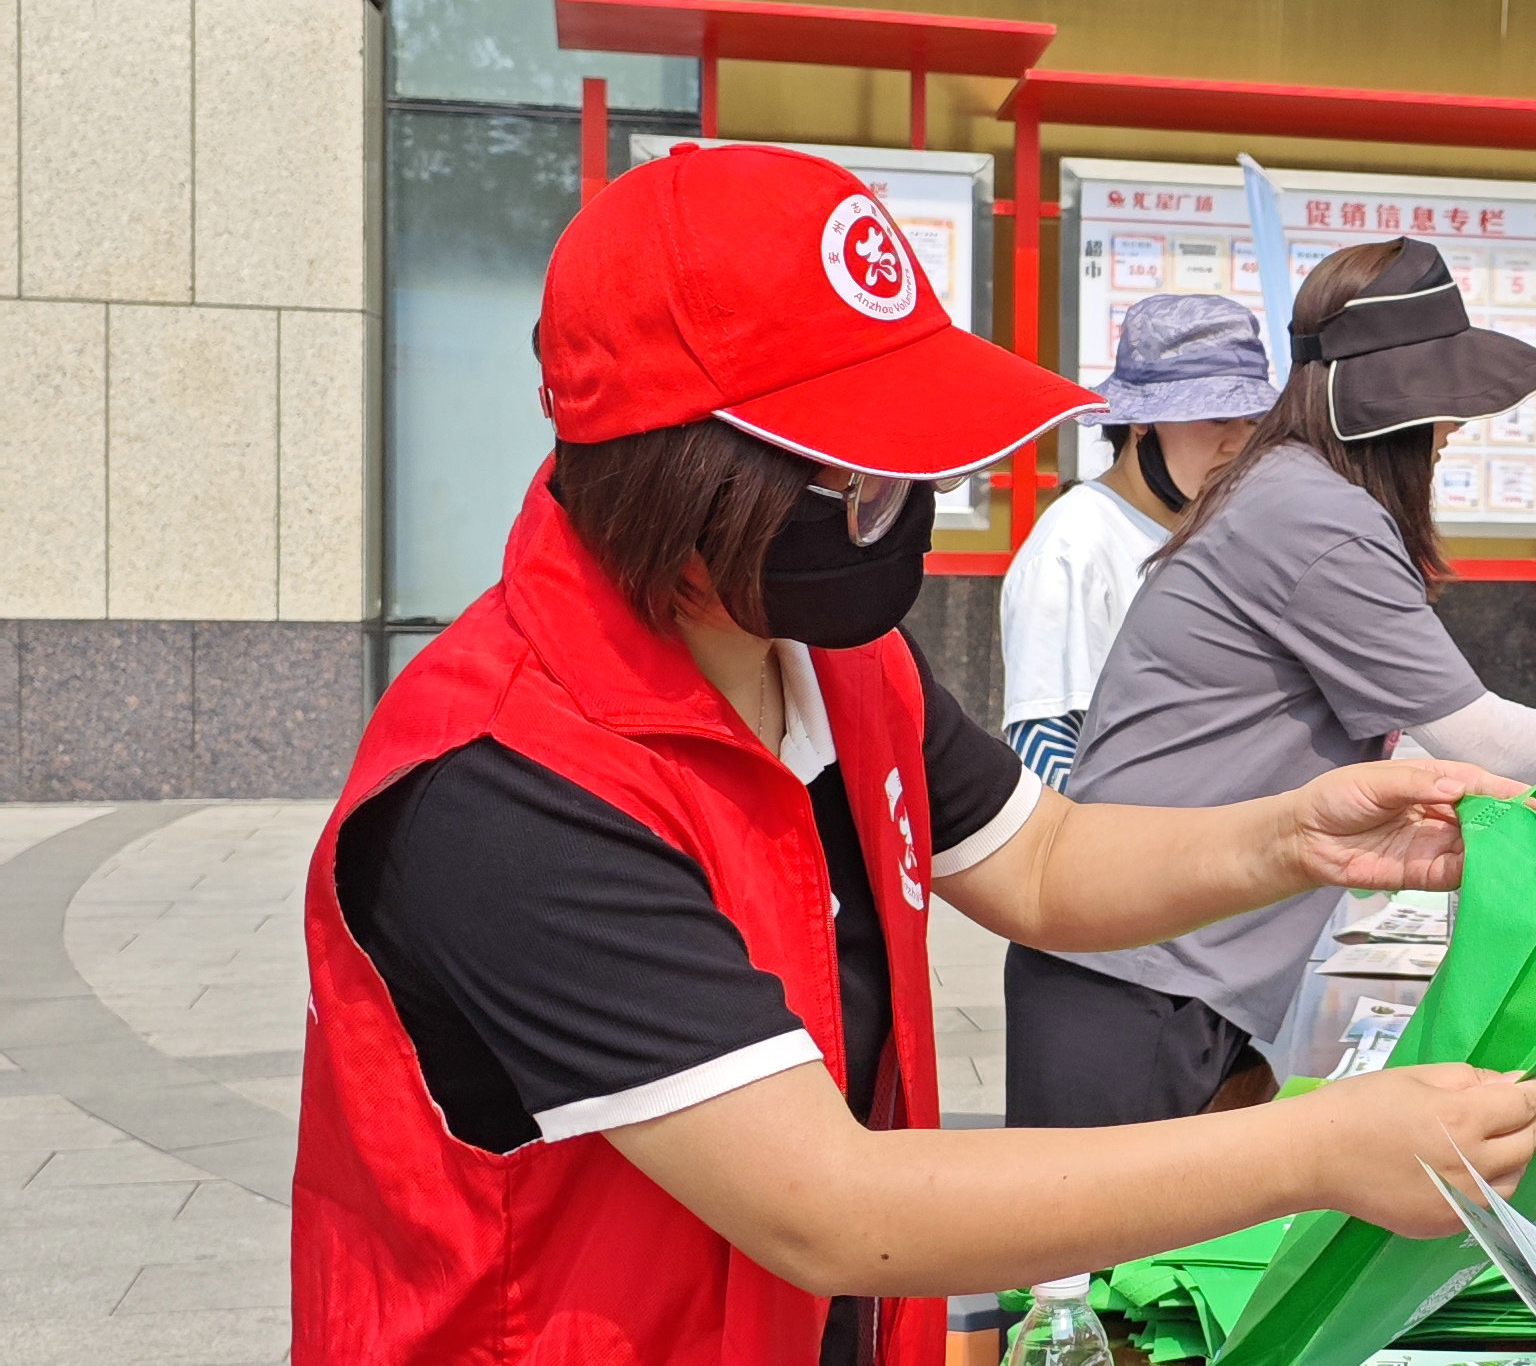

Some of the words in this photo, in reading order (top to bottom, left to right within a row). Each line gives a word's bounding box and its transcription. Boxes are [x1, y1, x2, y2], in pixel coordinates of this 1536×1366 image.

[1305, 199, 1506, 236] 促销信息专栏
[1085, 239, 1103, 279] 超市
